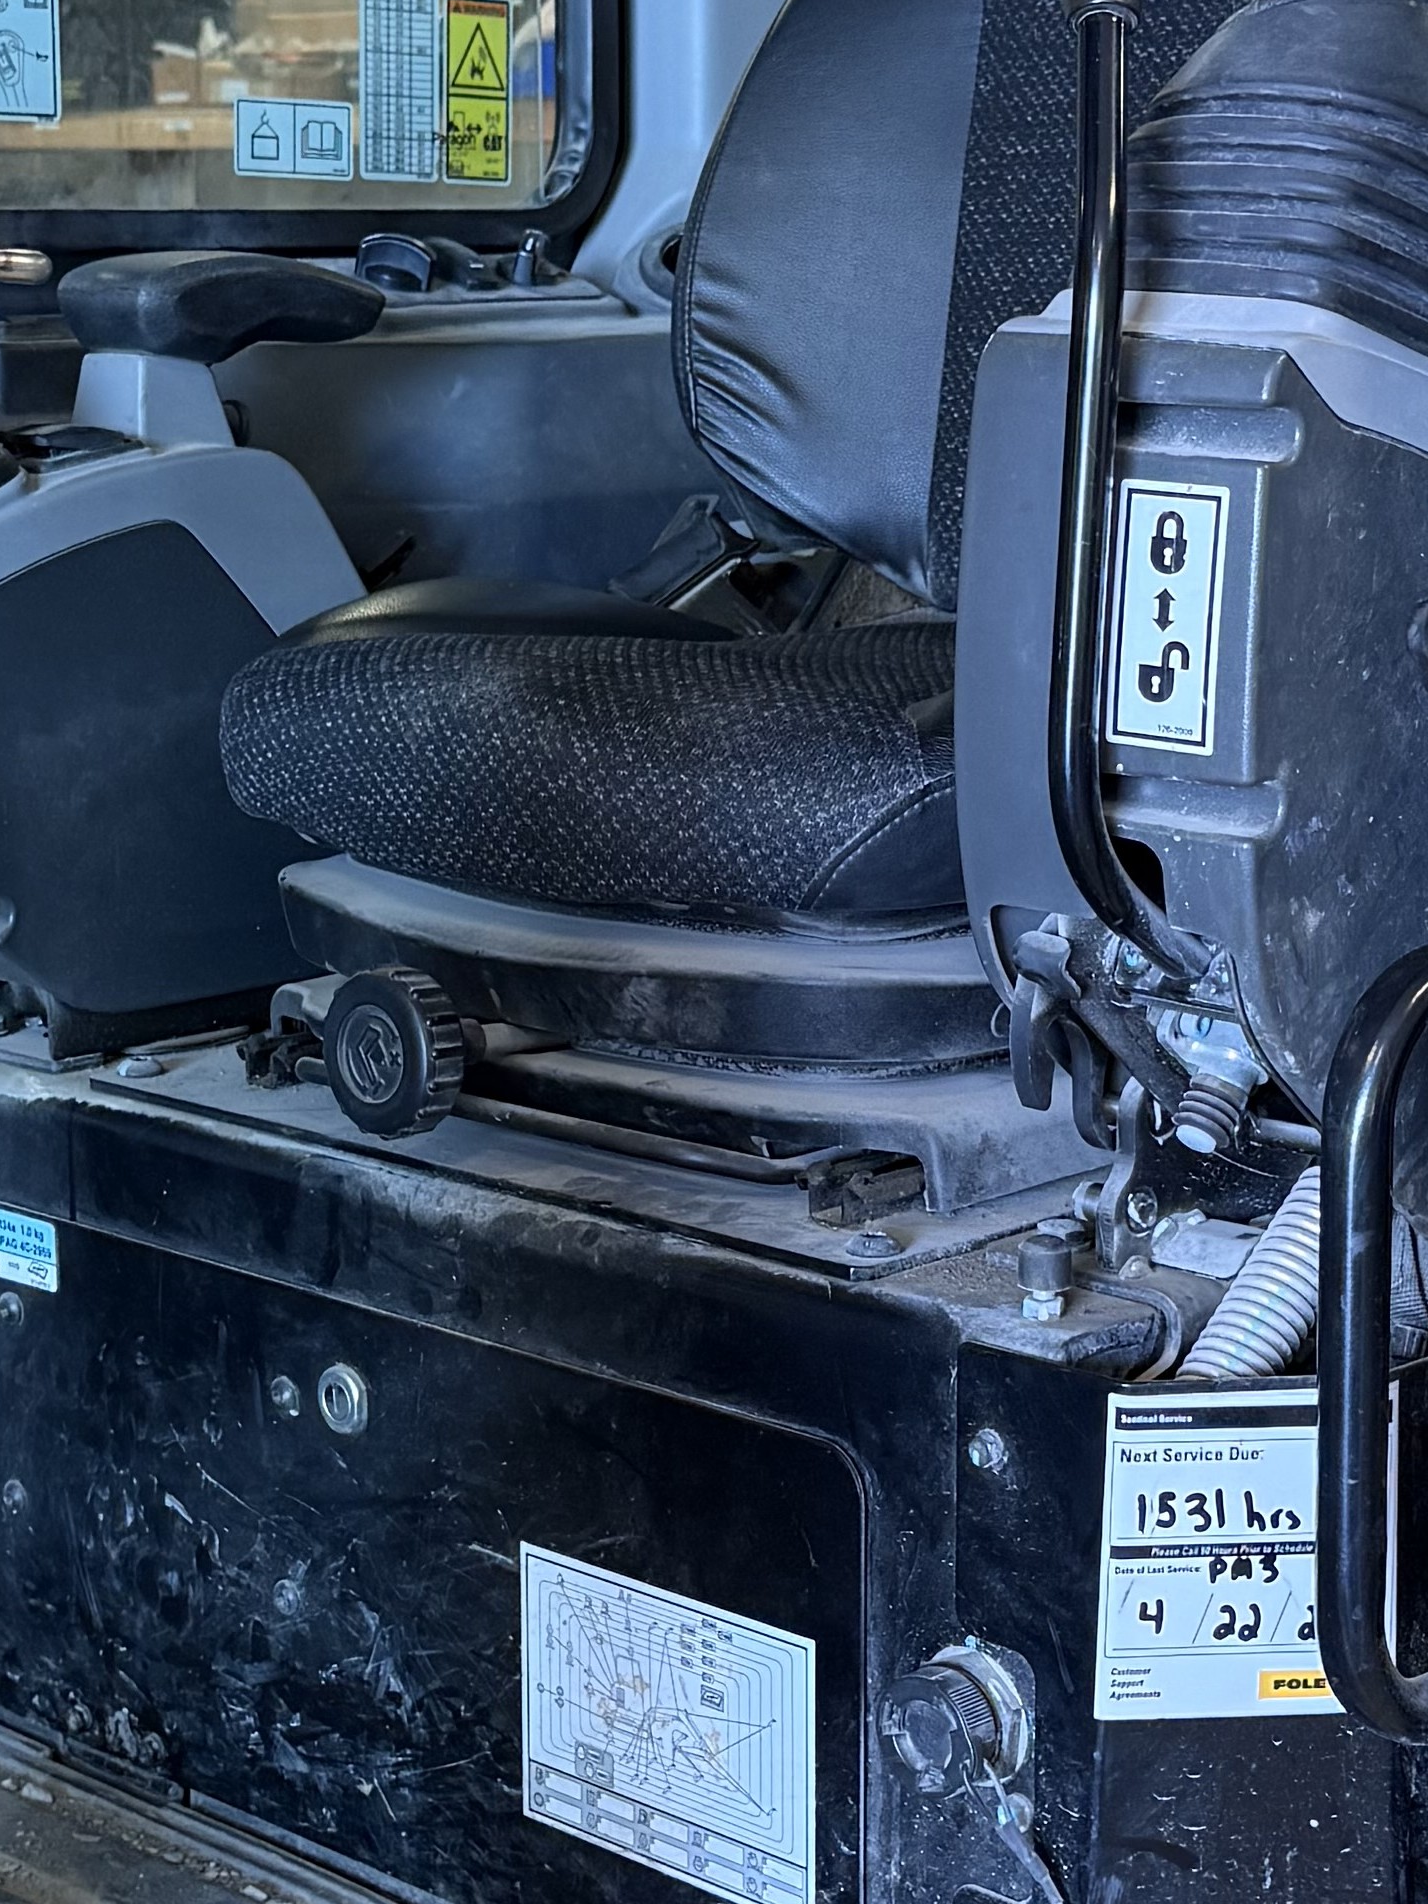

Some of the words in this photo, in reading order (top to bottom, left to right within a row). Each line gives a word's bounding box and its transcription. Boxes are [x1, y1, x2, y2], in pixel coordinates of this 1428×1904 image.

[1120, 1447, 1158, 1464] Next
[1162, 1446, 1223, 1463] Service
[1137, 1488, 1226, 1534] 1531
[1243, 1490, 1302, 1532] hrs
[1138, 1598, 1165, 1635] 4
[1212, 1603, 1262, 1642] 22
[1273, 1677, 1327, 1690] FOLE
